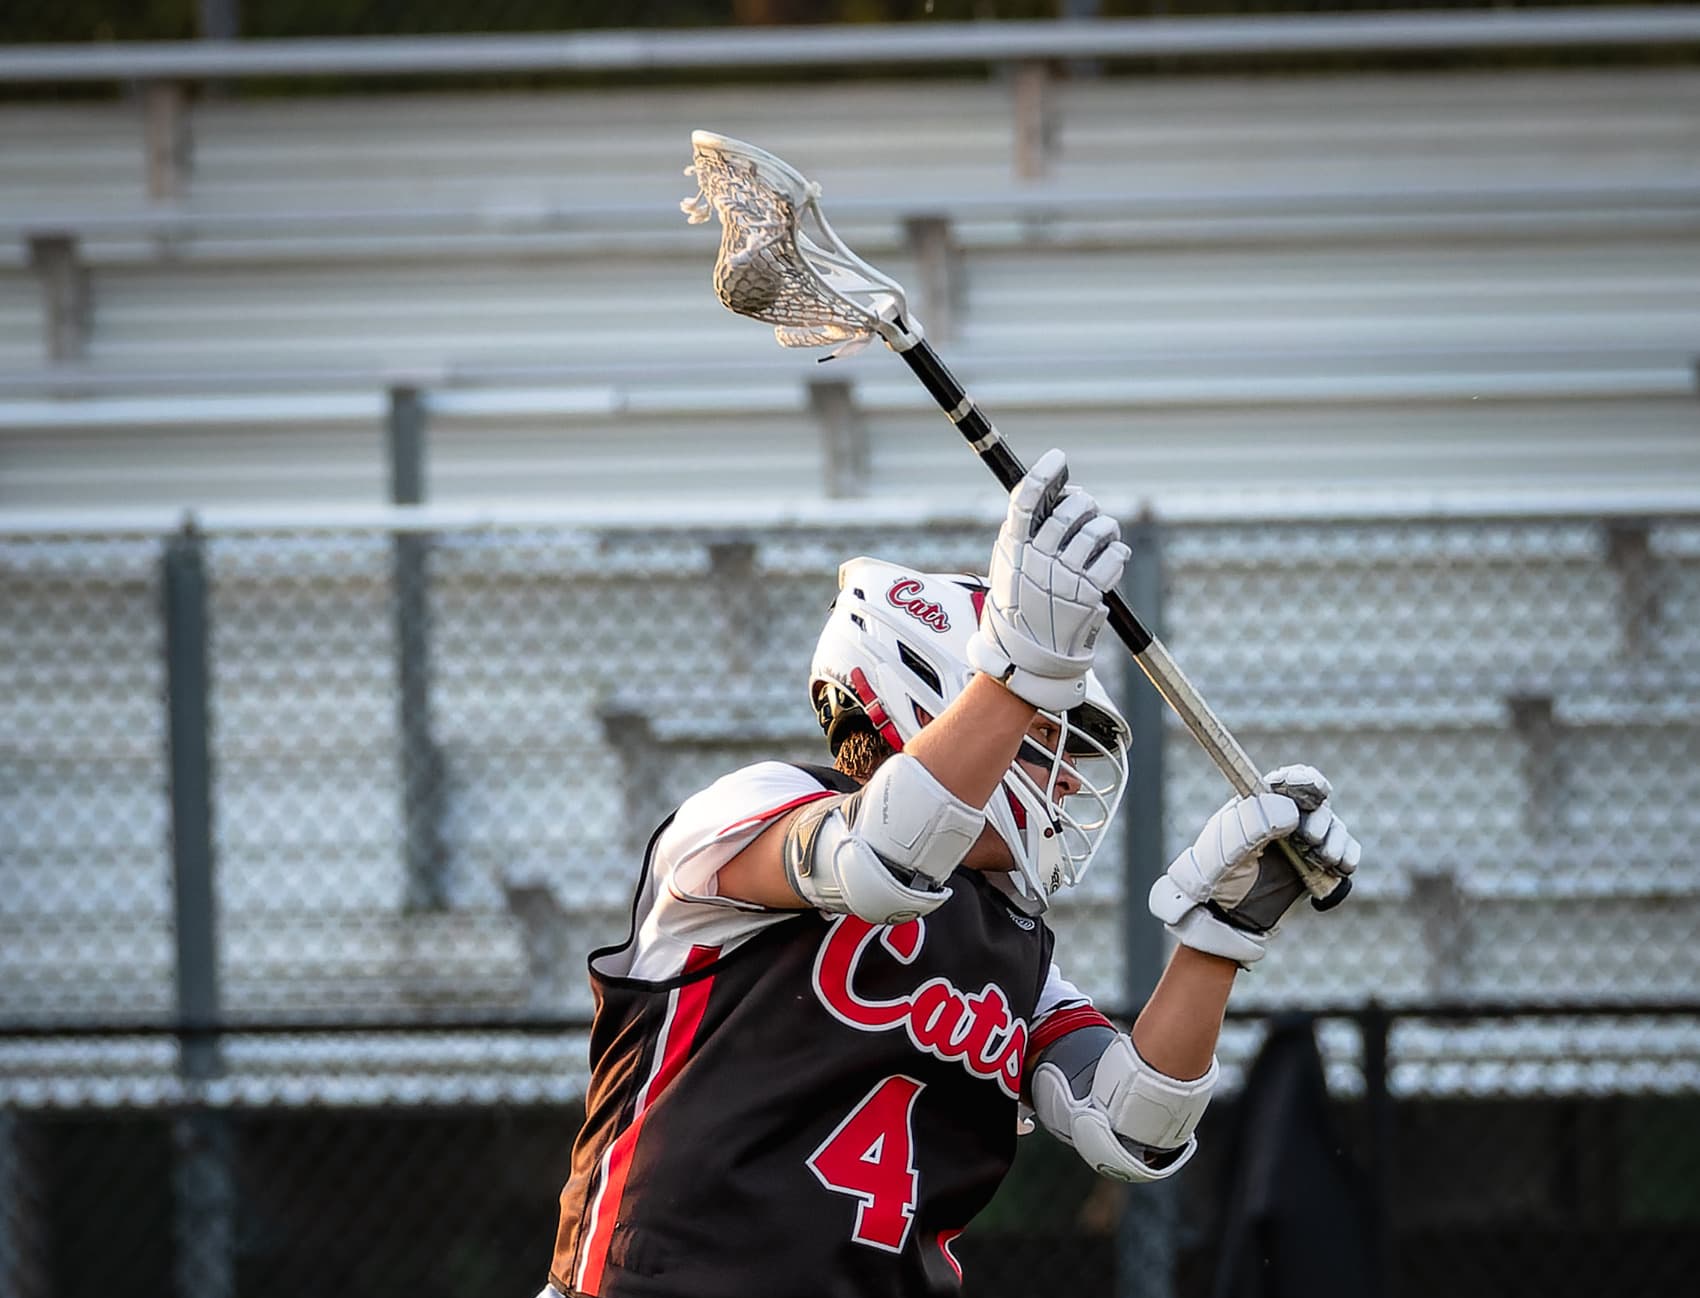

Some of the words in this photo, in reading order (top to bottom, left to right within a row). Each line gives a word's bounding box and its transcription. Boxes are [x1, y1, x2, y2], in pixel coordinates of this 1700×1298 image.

[886, 579, 951, 633] Cats
[812, 914, 1029, 1100] Cats
[805, 1073, 928, 1254] 4
